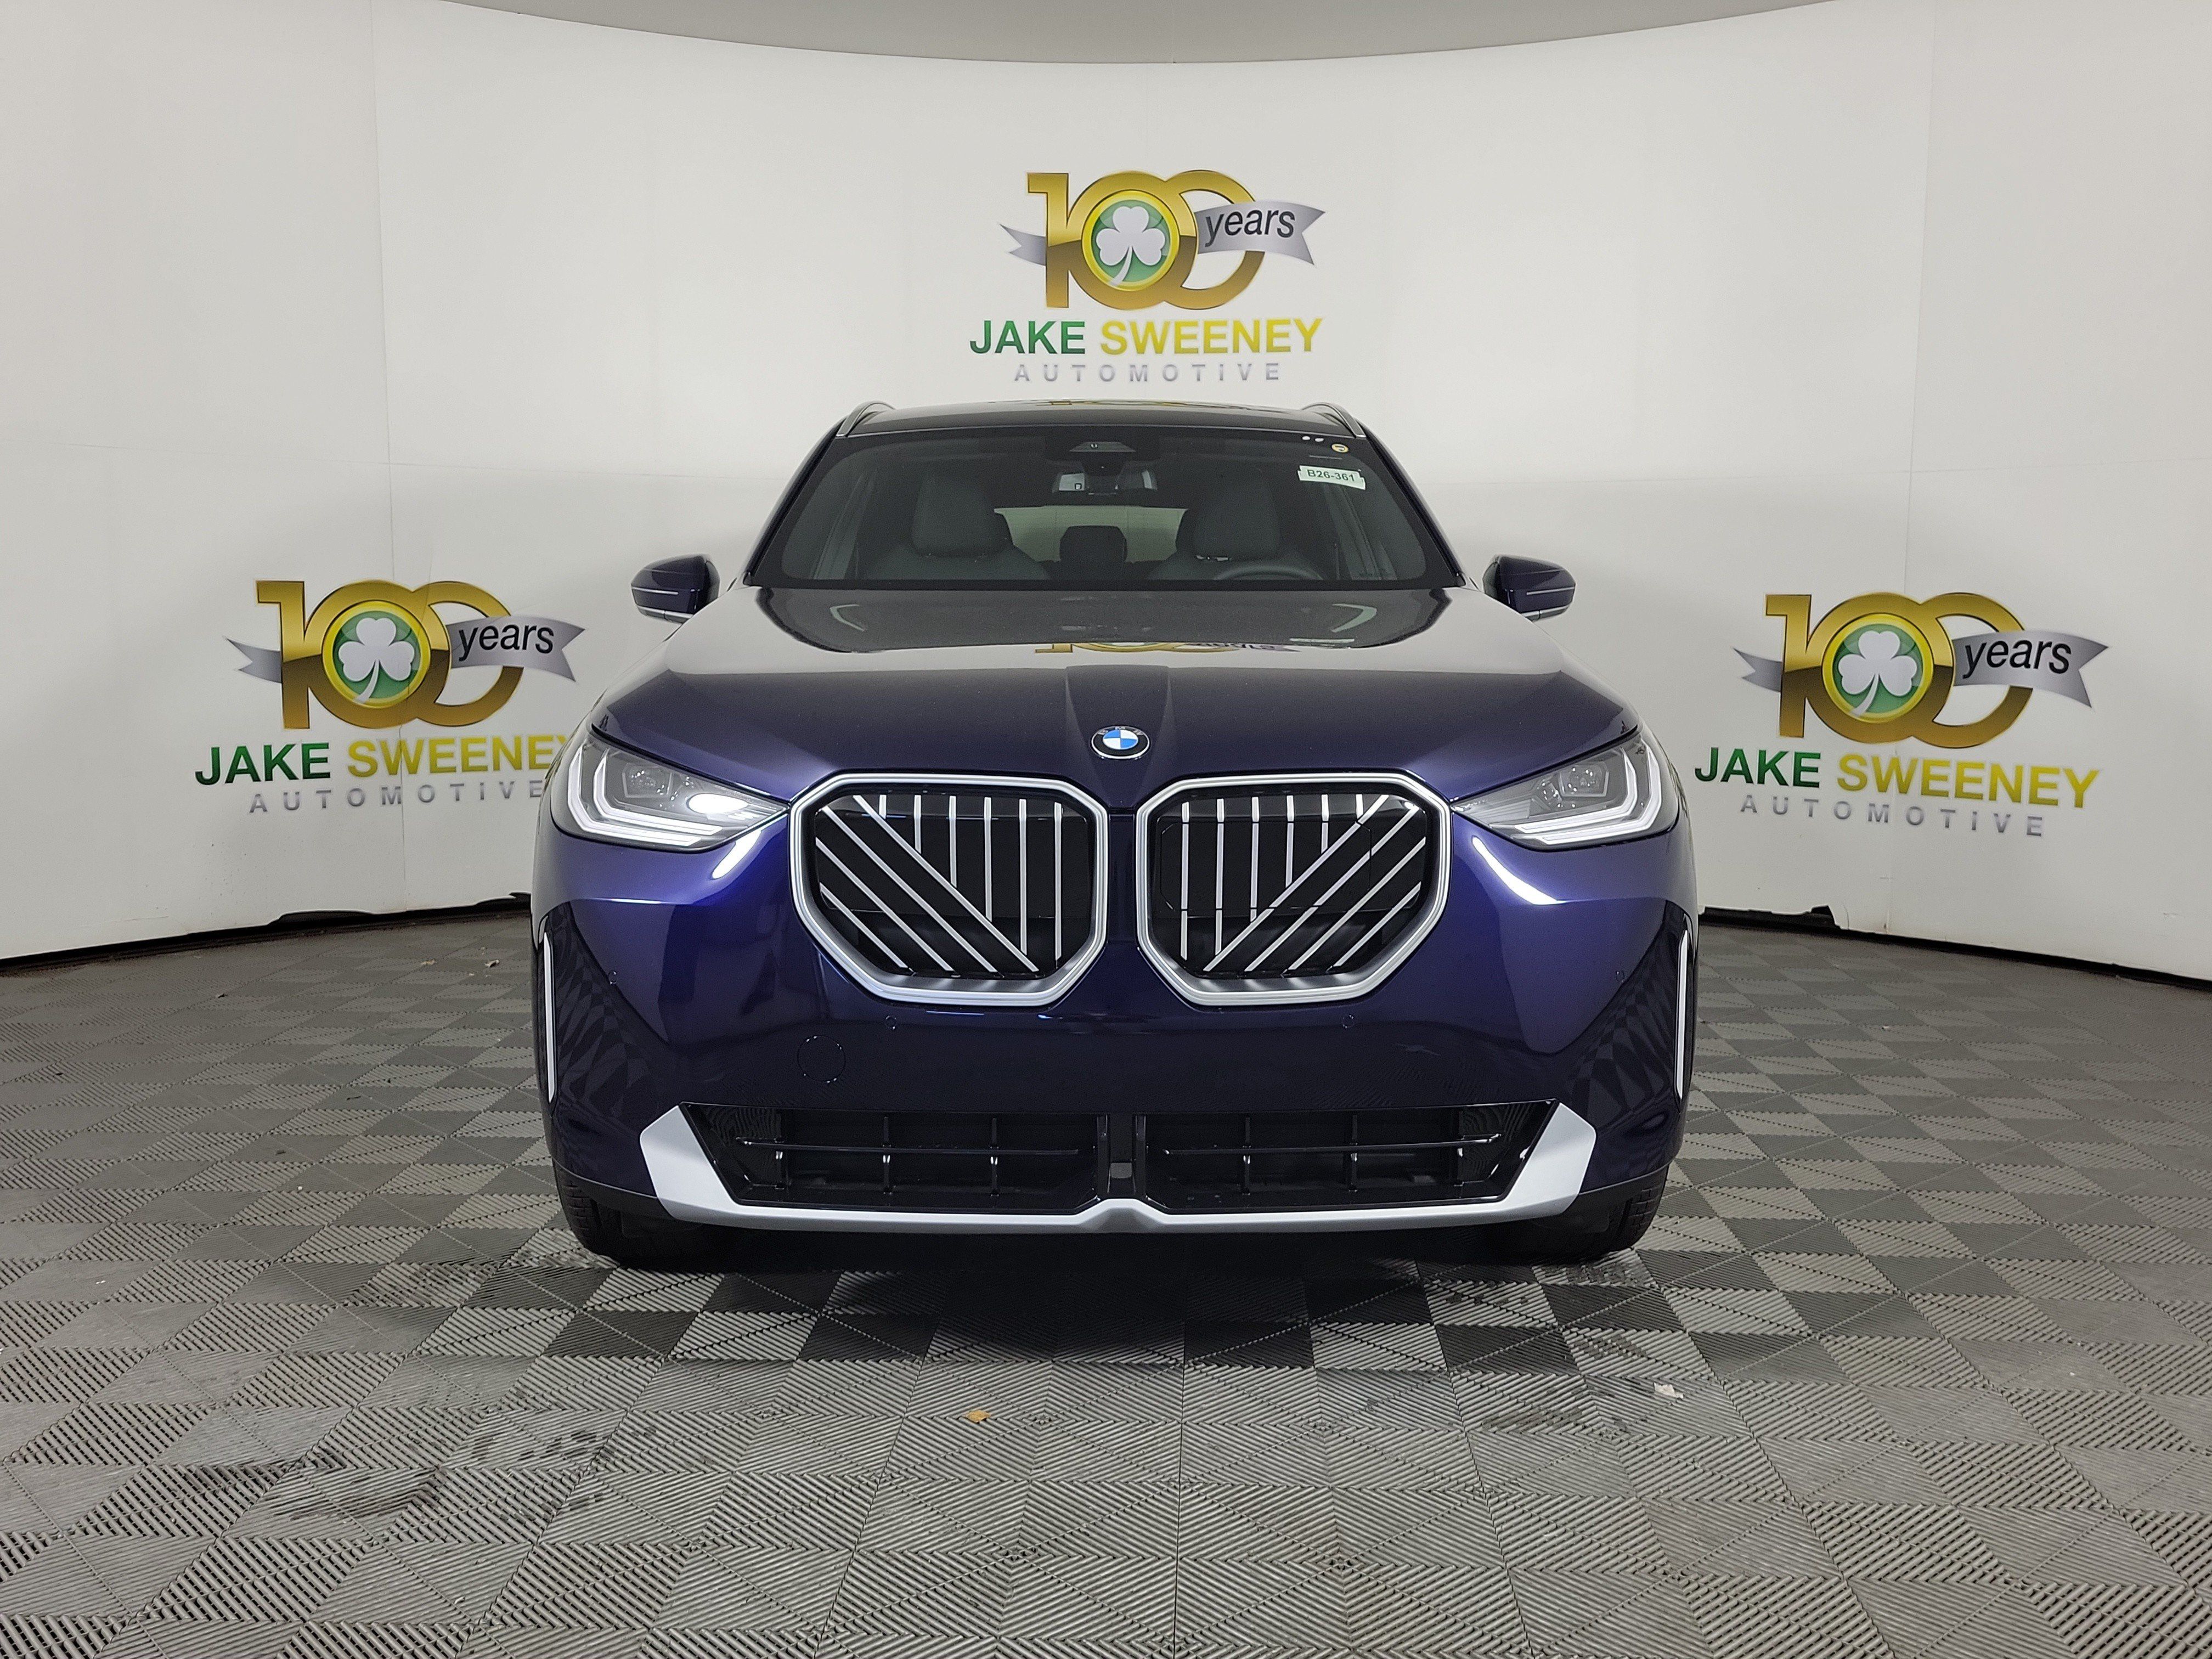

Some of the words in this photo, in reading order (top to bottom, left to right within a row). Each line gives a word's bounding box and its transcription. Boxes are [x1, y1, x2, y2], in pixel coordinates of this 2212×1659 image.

[1027, 170, 1265, 311] 100
[1205, 207, 1295, 247] years
[970, 320, 1086, 354] JAKE
[1101, 318, 1323, 355] SWEENEY
[1014, 363, 1279, 382] AUTOMOTIVE
[1307, 469, 1355, 482] B26-361
[255, 579, 524, 729] 100
[459, 623, 555, 661] years
[1962, 639, 2072, 680] years
[1765, 592, 2034, 748] 100
[195, 742, 330, 786] JAKE
[347, 734, 566, 777] SWEENE
[1694, 747, 1821, 788] JAKE
[1837, 753, 2100, 808] SWEENEY
[249, 780, 543, 814] AUTOMOTIVE
[1740, 794, 2043, 837] AUTOMOTIVE
